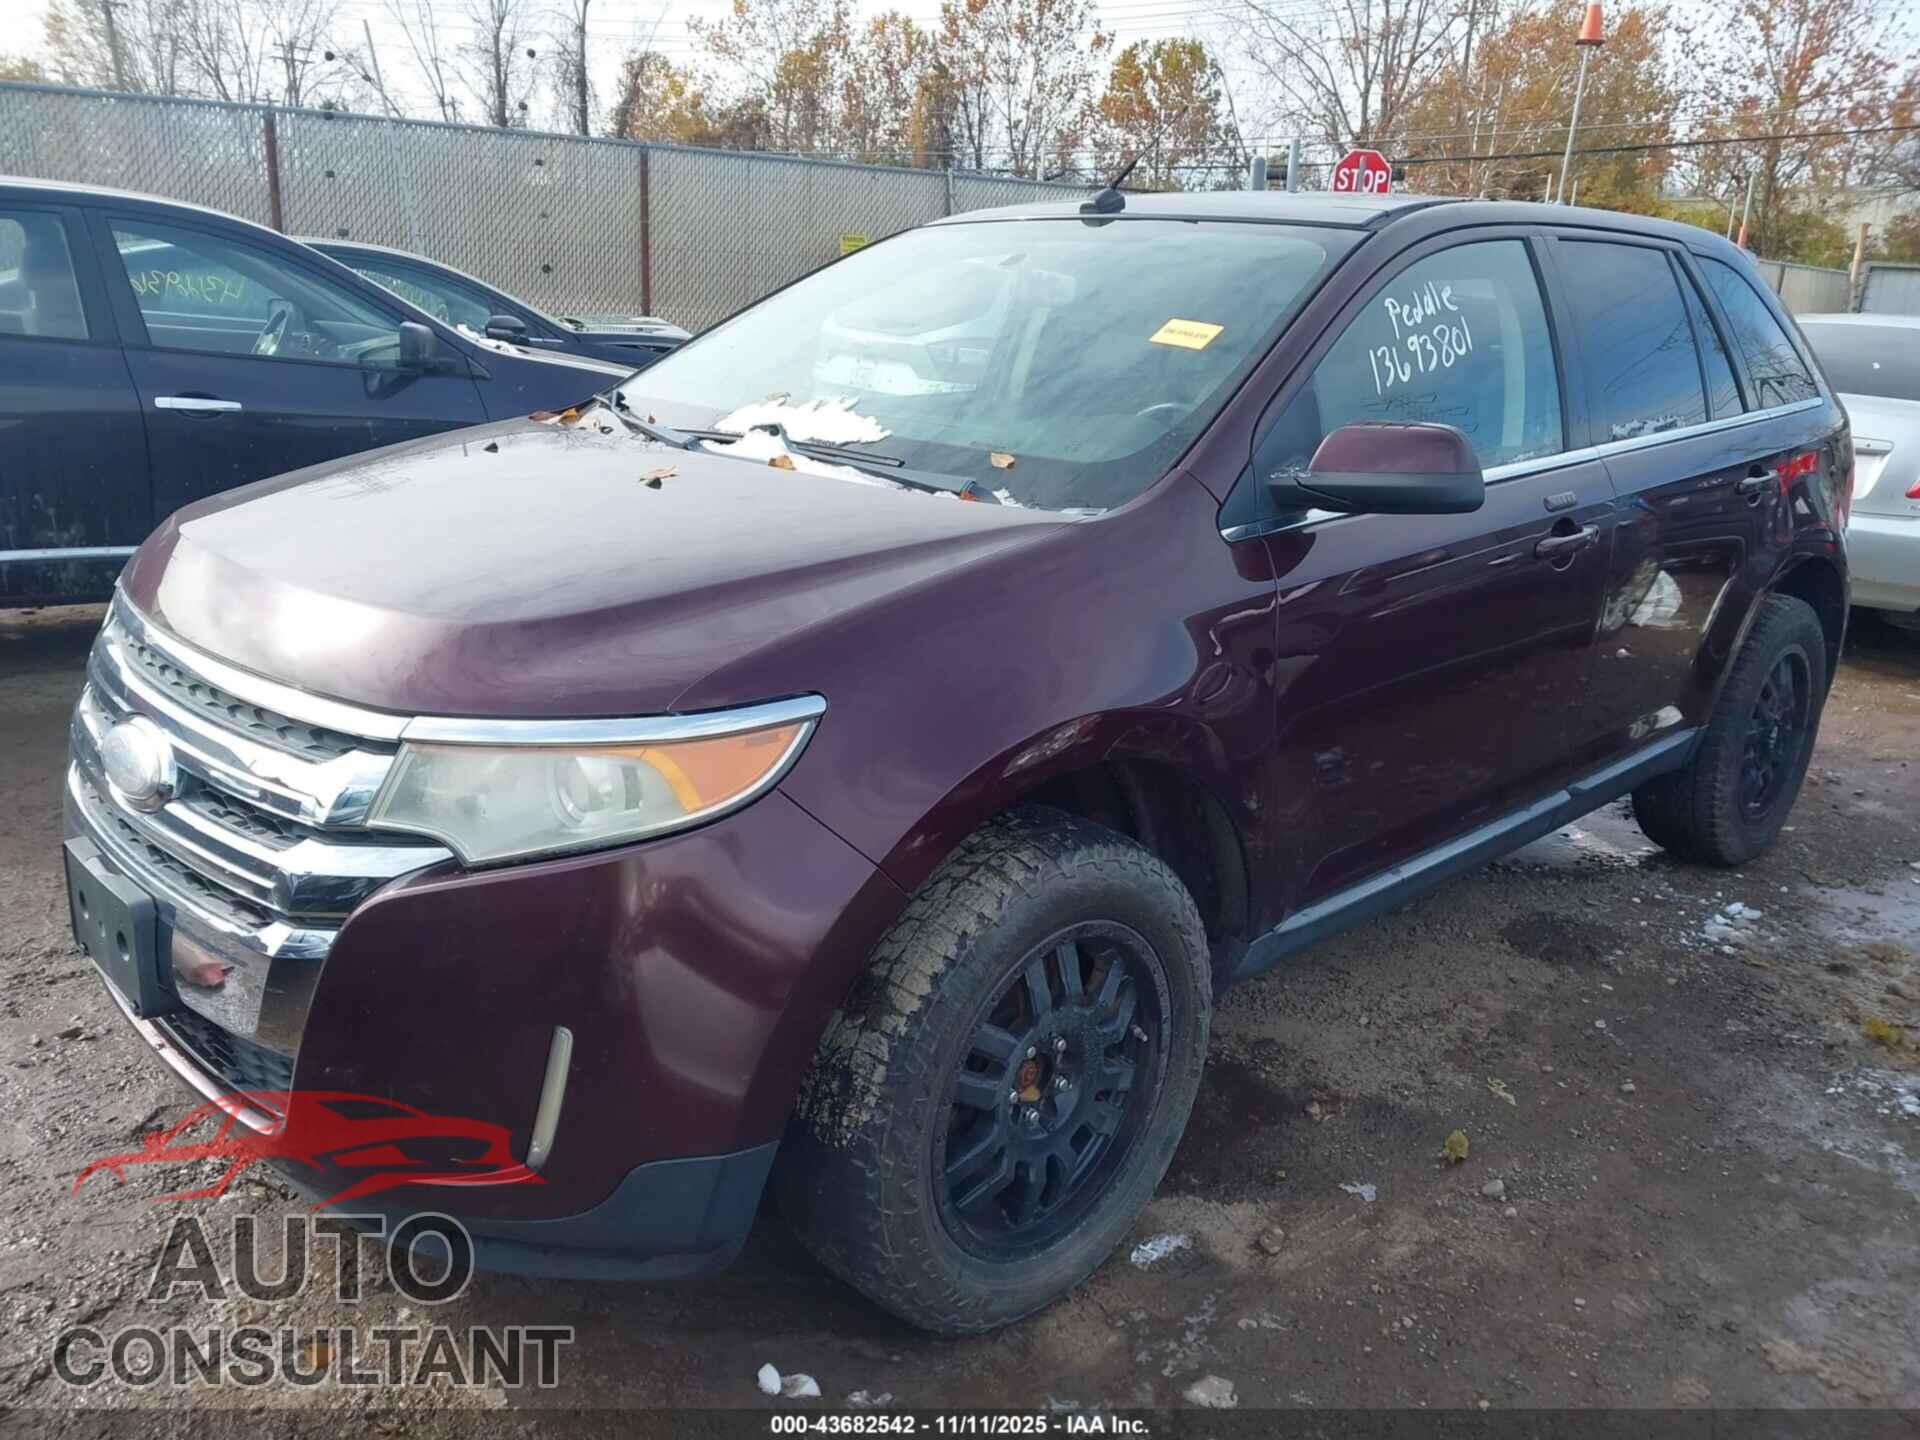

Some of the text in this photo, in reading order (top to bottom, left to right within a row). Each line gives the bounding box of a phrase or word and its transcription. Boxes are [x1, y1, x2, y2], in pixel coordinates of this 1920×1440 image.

[1337, 168, 1387, 193] STOP
[1384, 281, 1459, 340] Peddle
[1369, 316, 1473, 395] 13693801
